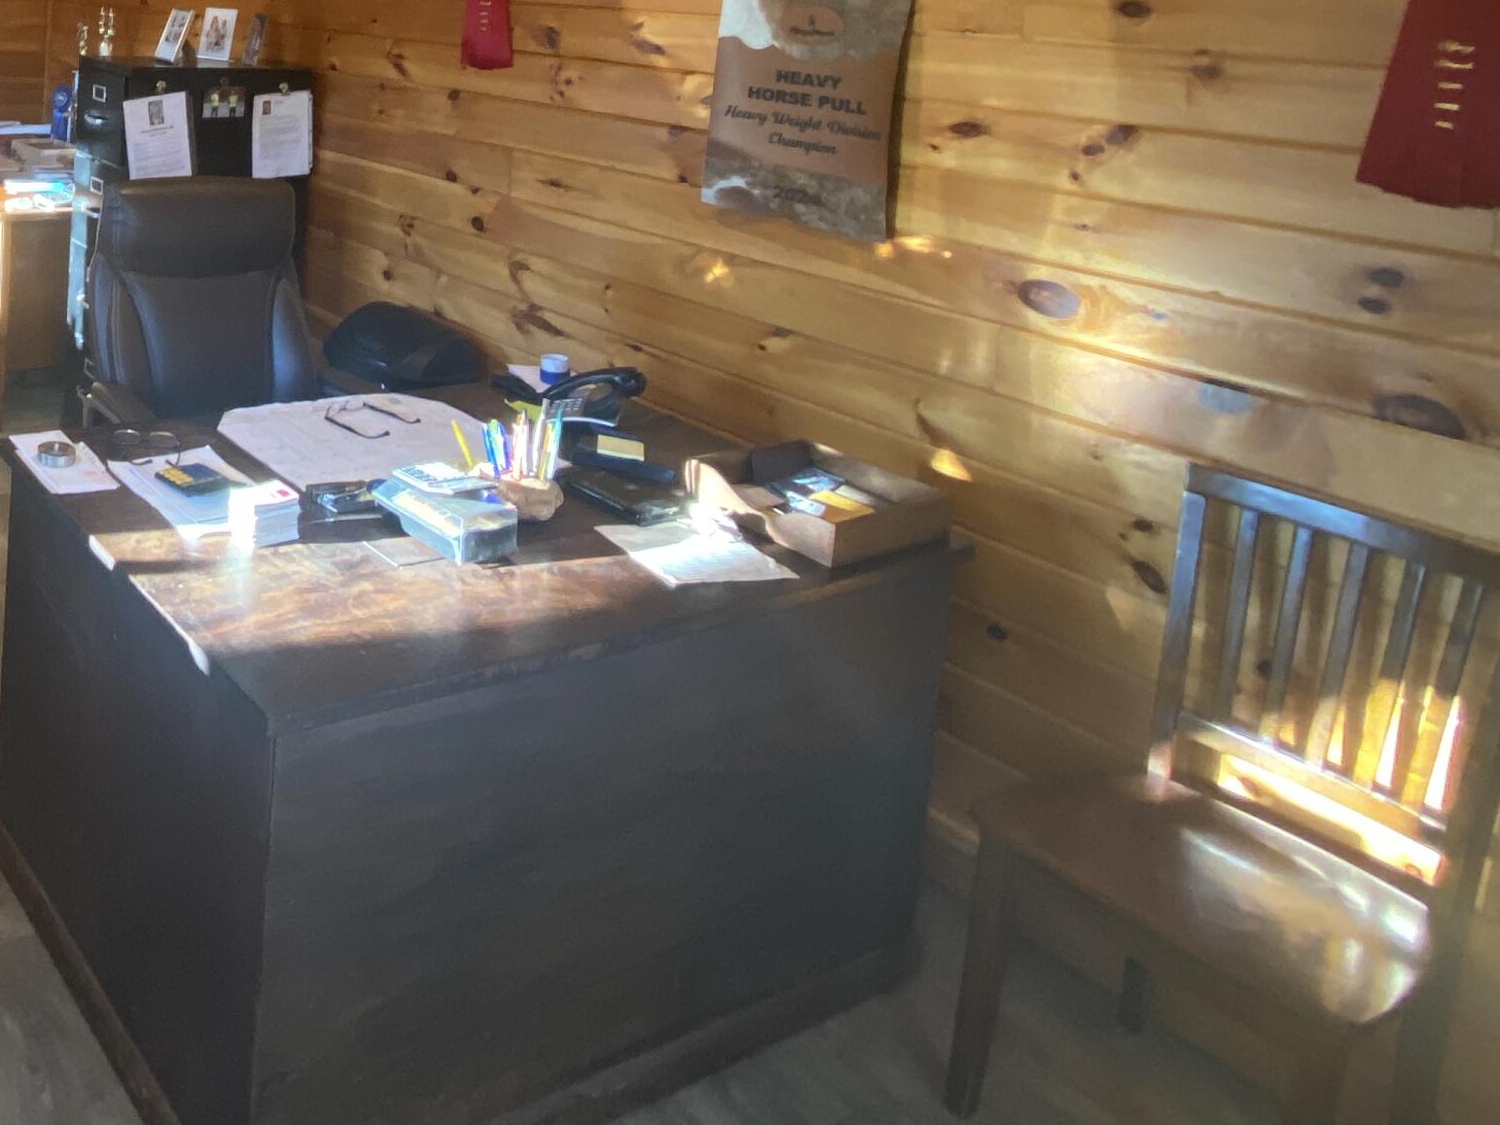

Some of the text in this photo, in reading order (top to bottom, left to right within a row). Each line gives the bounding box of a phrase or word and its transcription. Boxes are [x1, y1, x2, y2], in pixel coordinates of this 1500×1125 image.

[775, 69, 842, 89] HEAVY
[747, 86, 866, 116] HORSE PULL
[724, 105, 767, 125] Heavy
[771, 111, 822, 133] Weight
[768, 132, 838, 155] Champion
